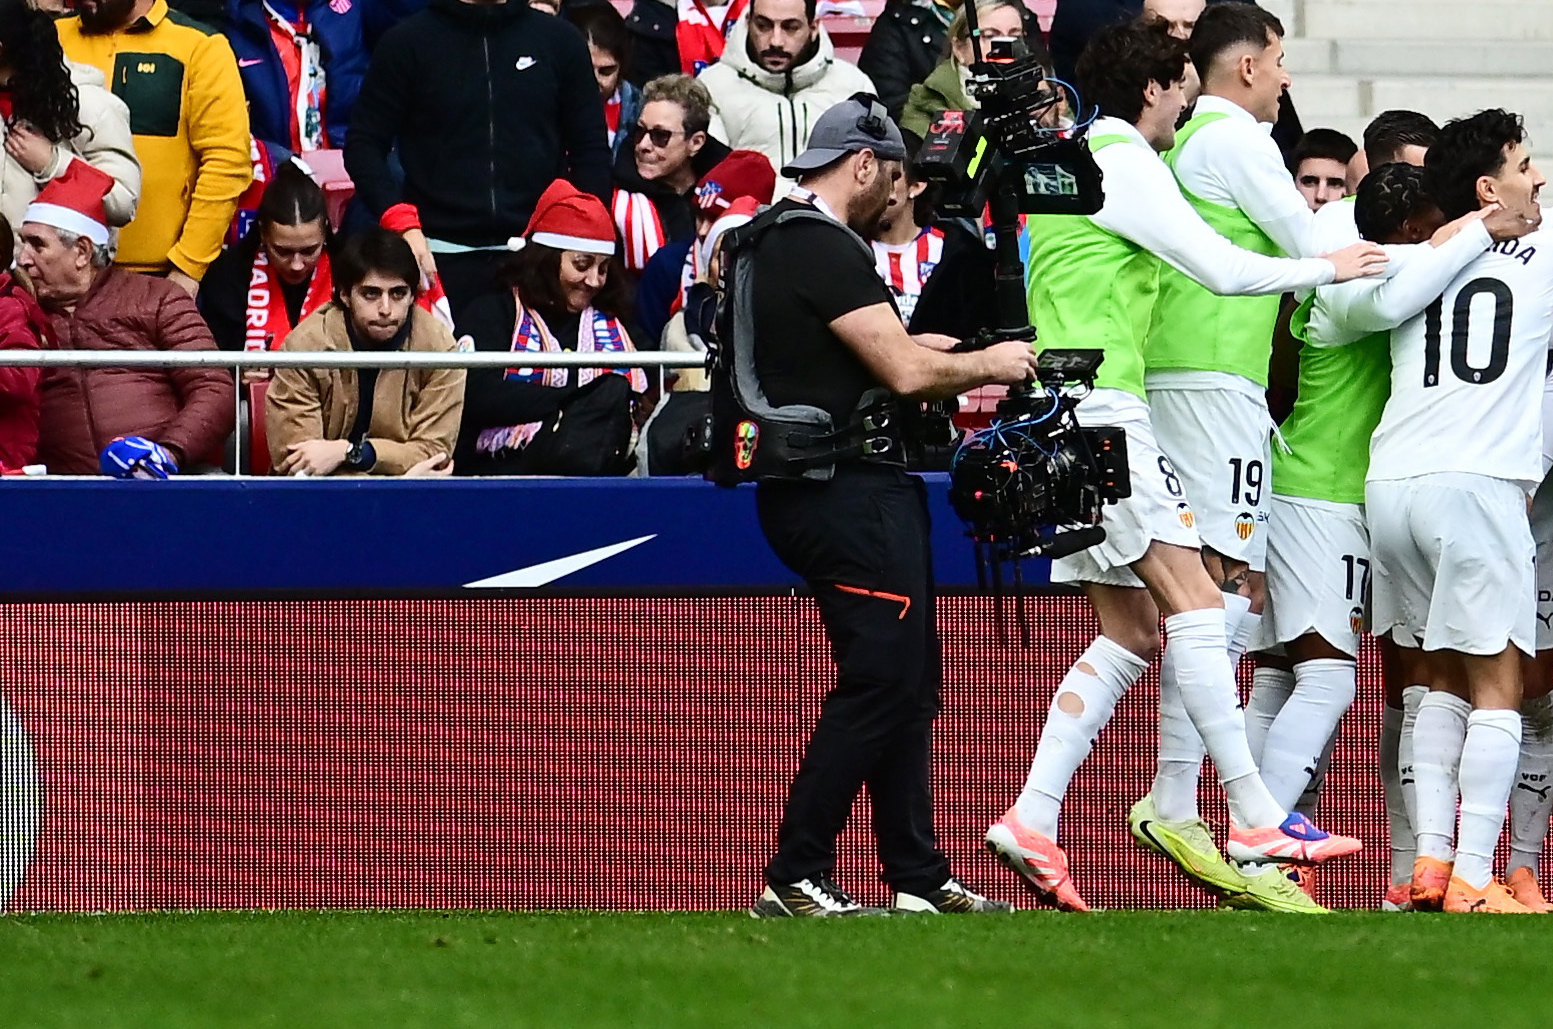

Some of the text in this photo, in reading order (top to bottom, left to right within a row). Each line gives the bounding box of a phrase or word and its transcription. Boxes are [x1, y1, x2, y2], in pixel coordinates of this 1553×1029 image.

[1423, 276, 1514, 388] 10
[1157, 455, 1182, 497] 8
[1228, 457, 1263, 507] 19
[1341, 554, 1370, 604] 17
[1401, 766, 1414, 776] VC
[1520, 772, 1547, 783] VCF
